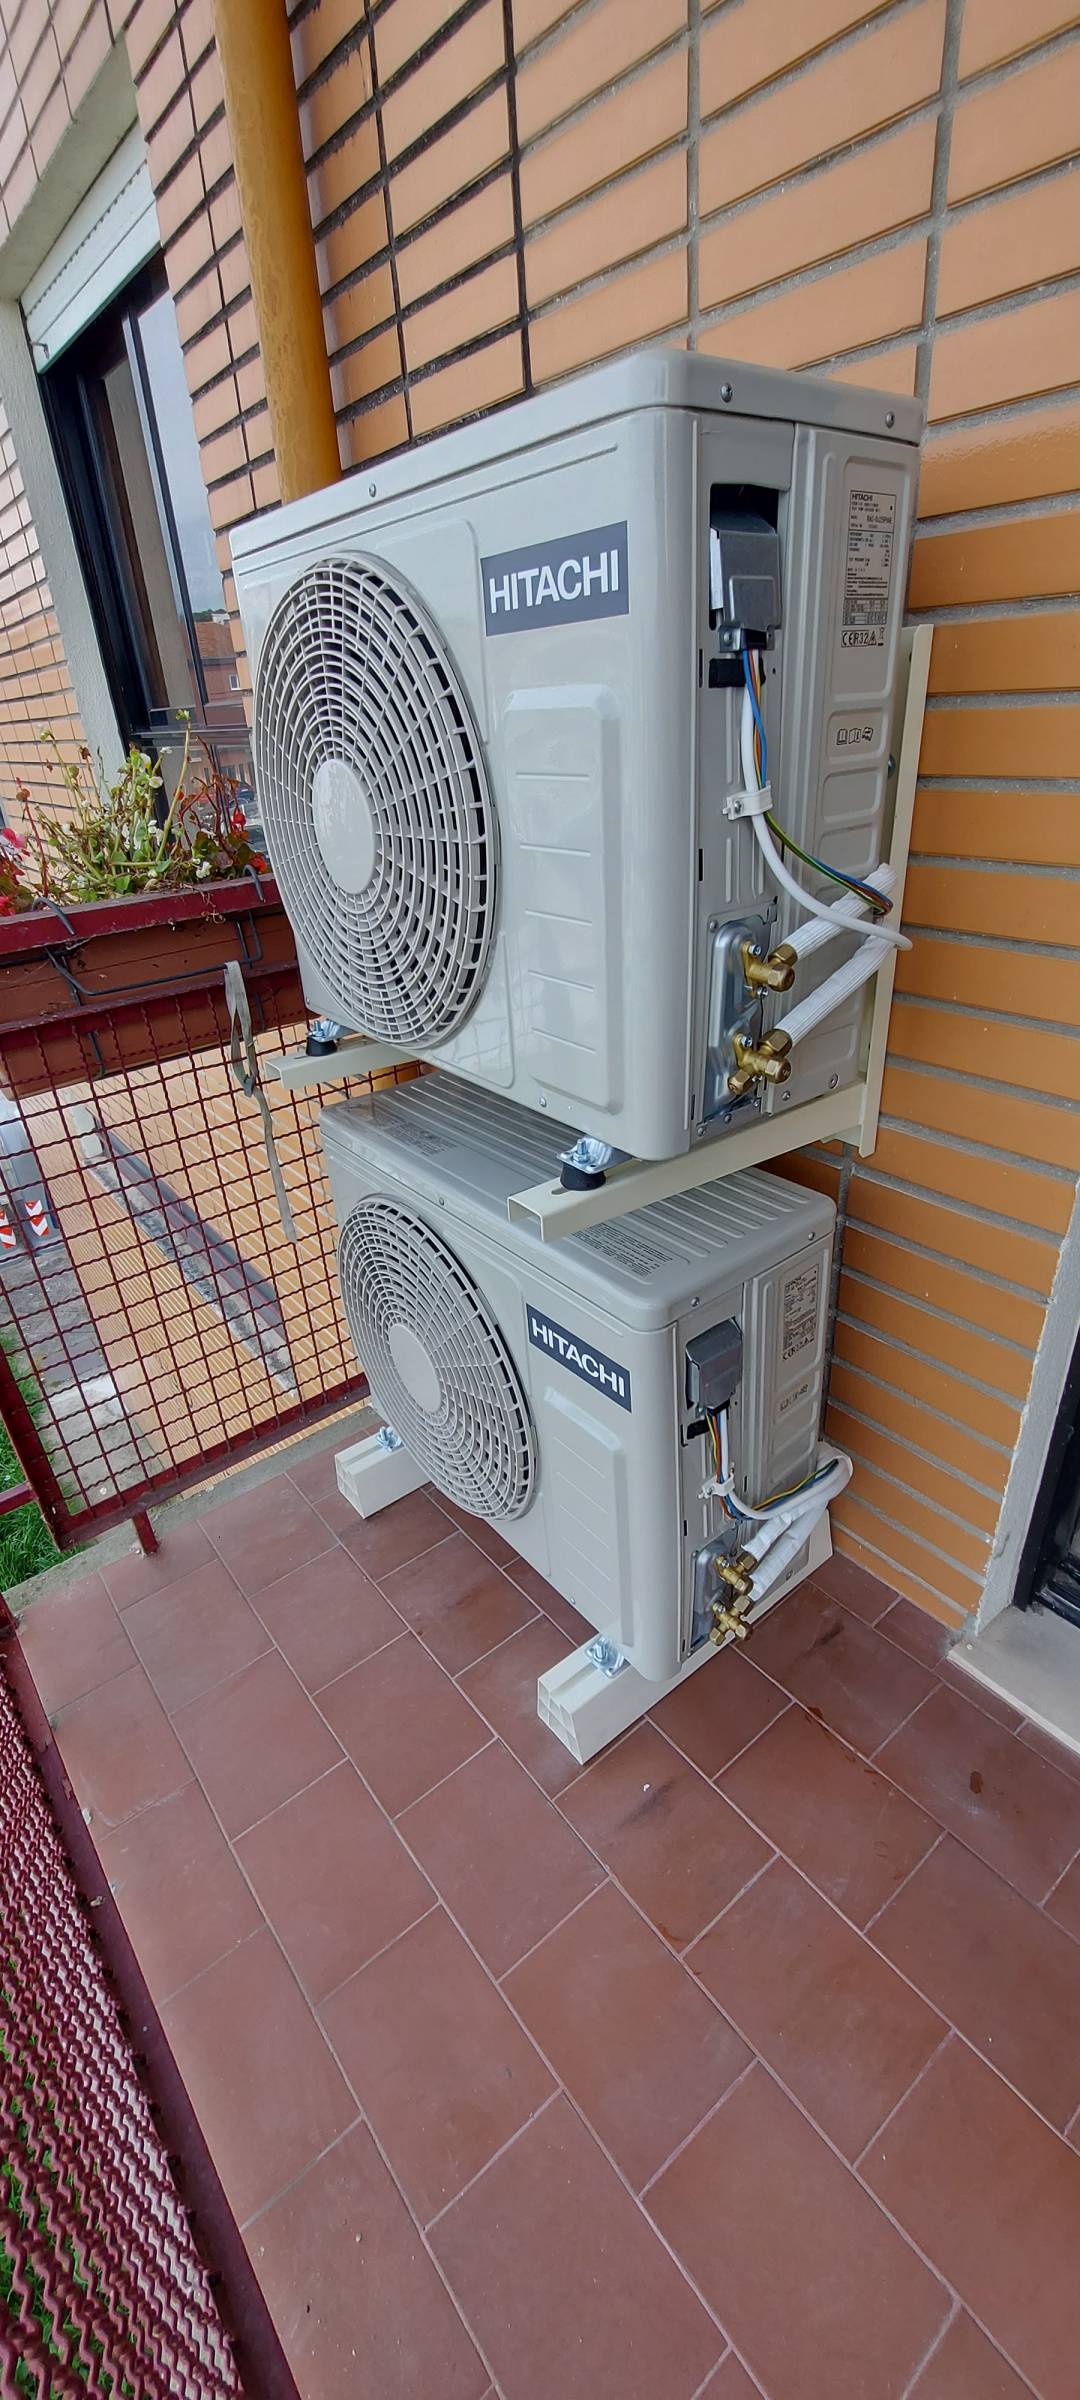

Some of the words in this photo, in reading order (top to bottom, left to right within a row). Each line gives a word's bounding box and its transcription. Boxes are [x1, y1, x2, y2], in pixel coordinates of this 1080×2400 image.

[851, 493, 873, 502] HITACHI
[489, 549, 619, 614] HITACHI
[532, 1317, 625, 1398] HITACHI
